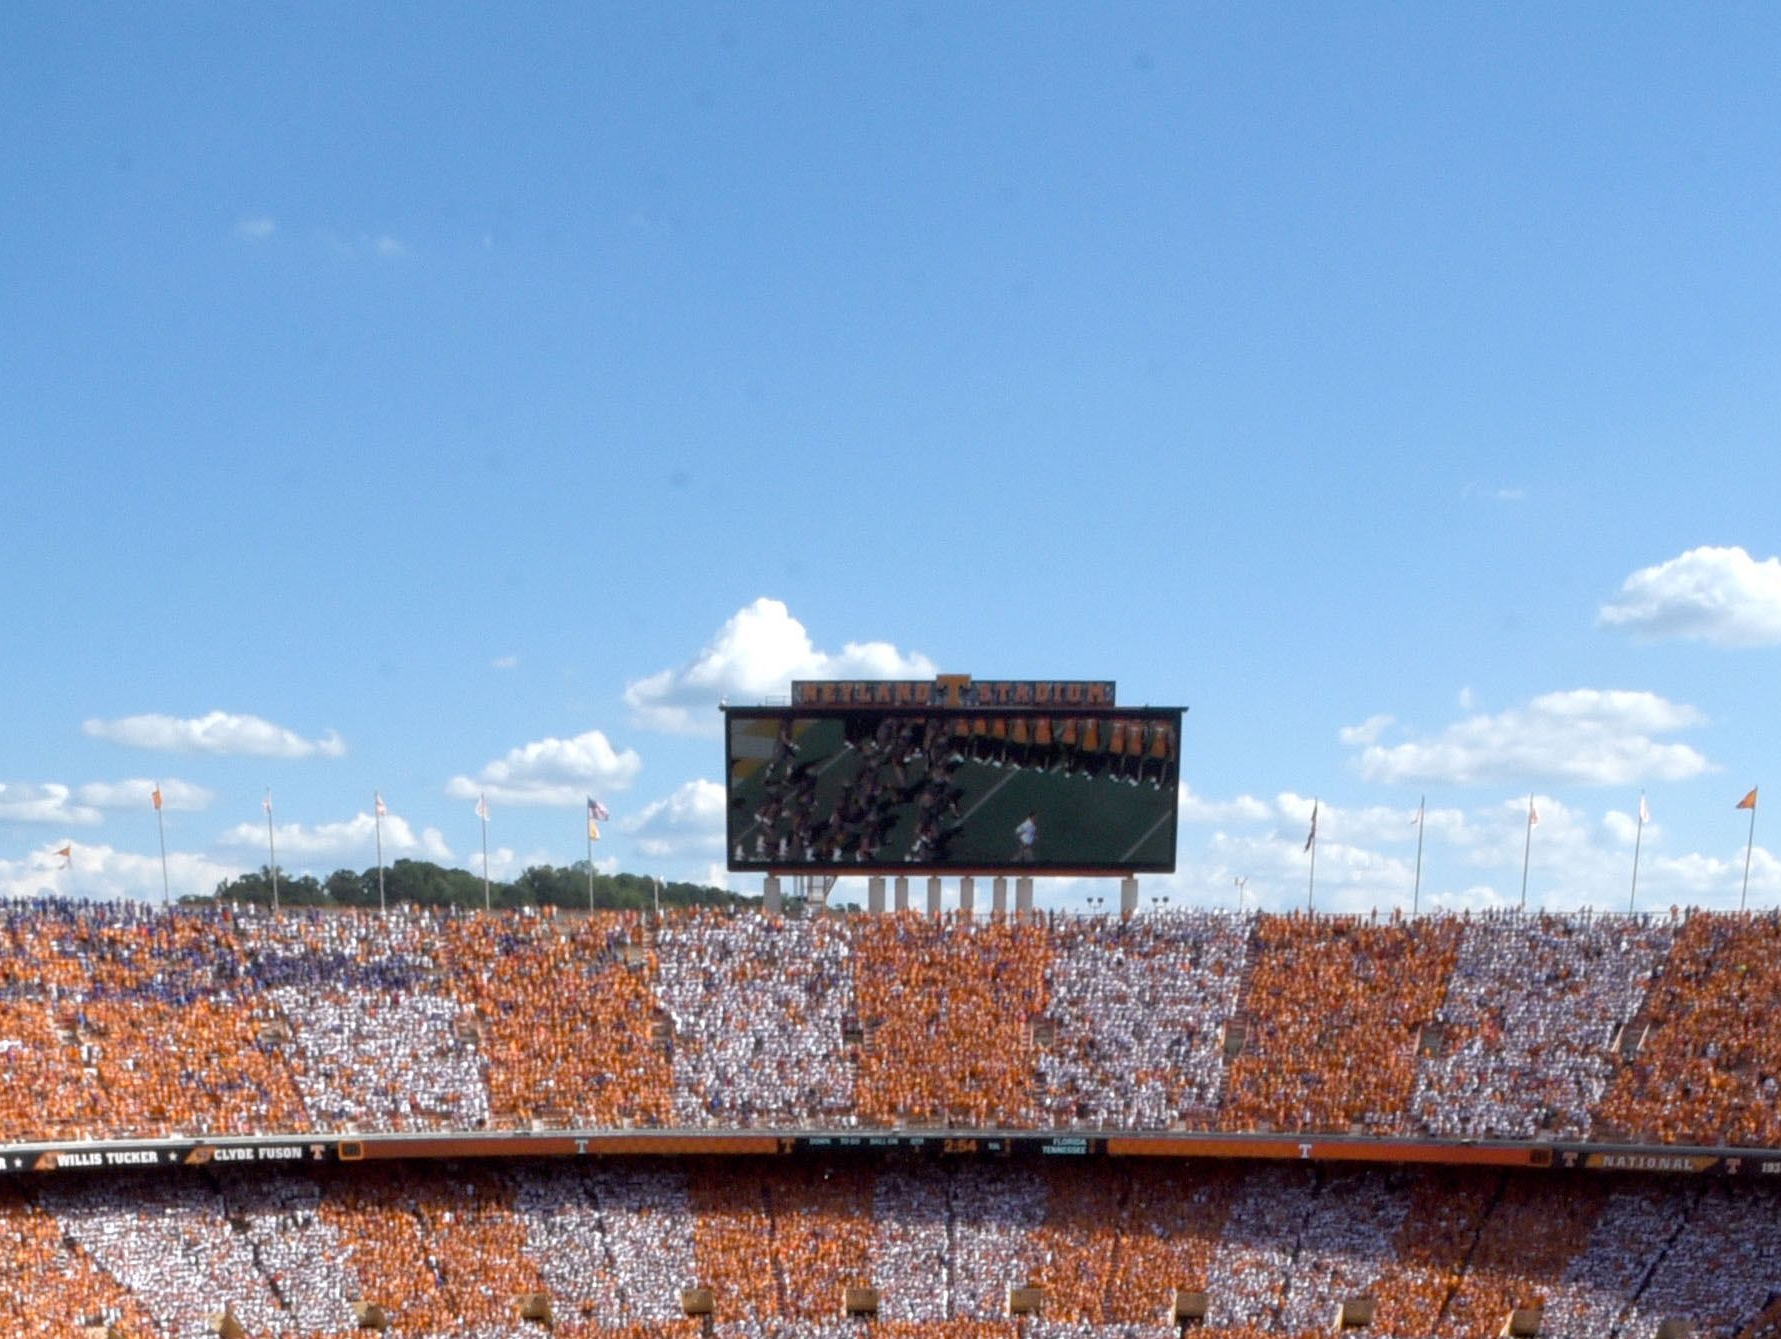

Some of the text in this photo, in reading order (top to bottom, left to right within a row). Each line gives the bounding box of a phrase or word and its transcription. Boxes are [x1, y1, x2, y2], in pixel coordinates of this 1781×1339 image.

[803, 684, 930, 704] NEYLAND
[978, 684, 1107, 704] STADIUM
[57, 1151, 158, 1167] WILLIS TUCKER
[1603, 1155, 1693, 1171] NATIONAL
